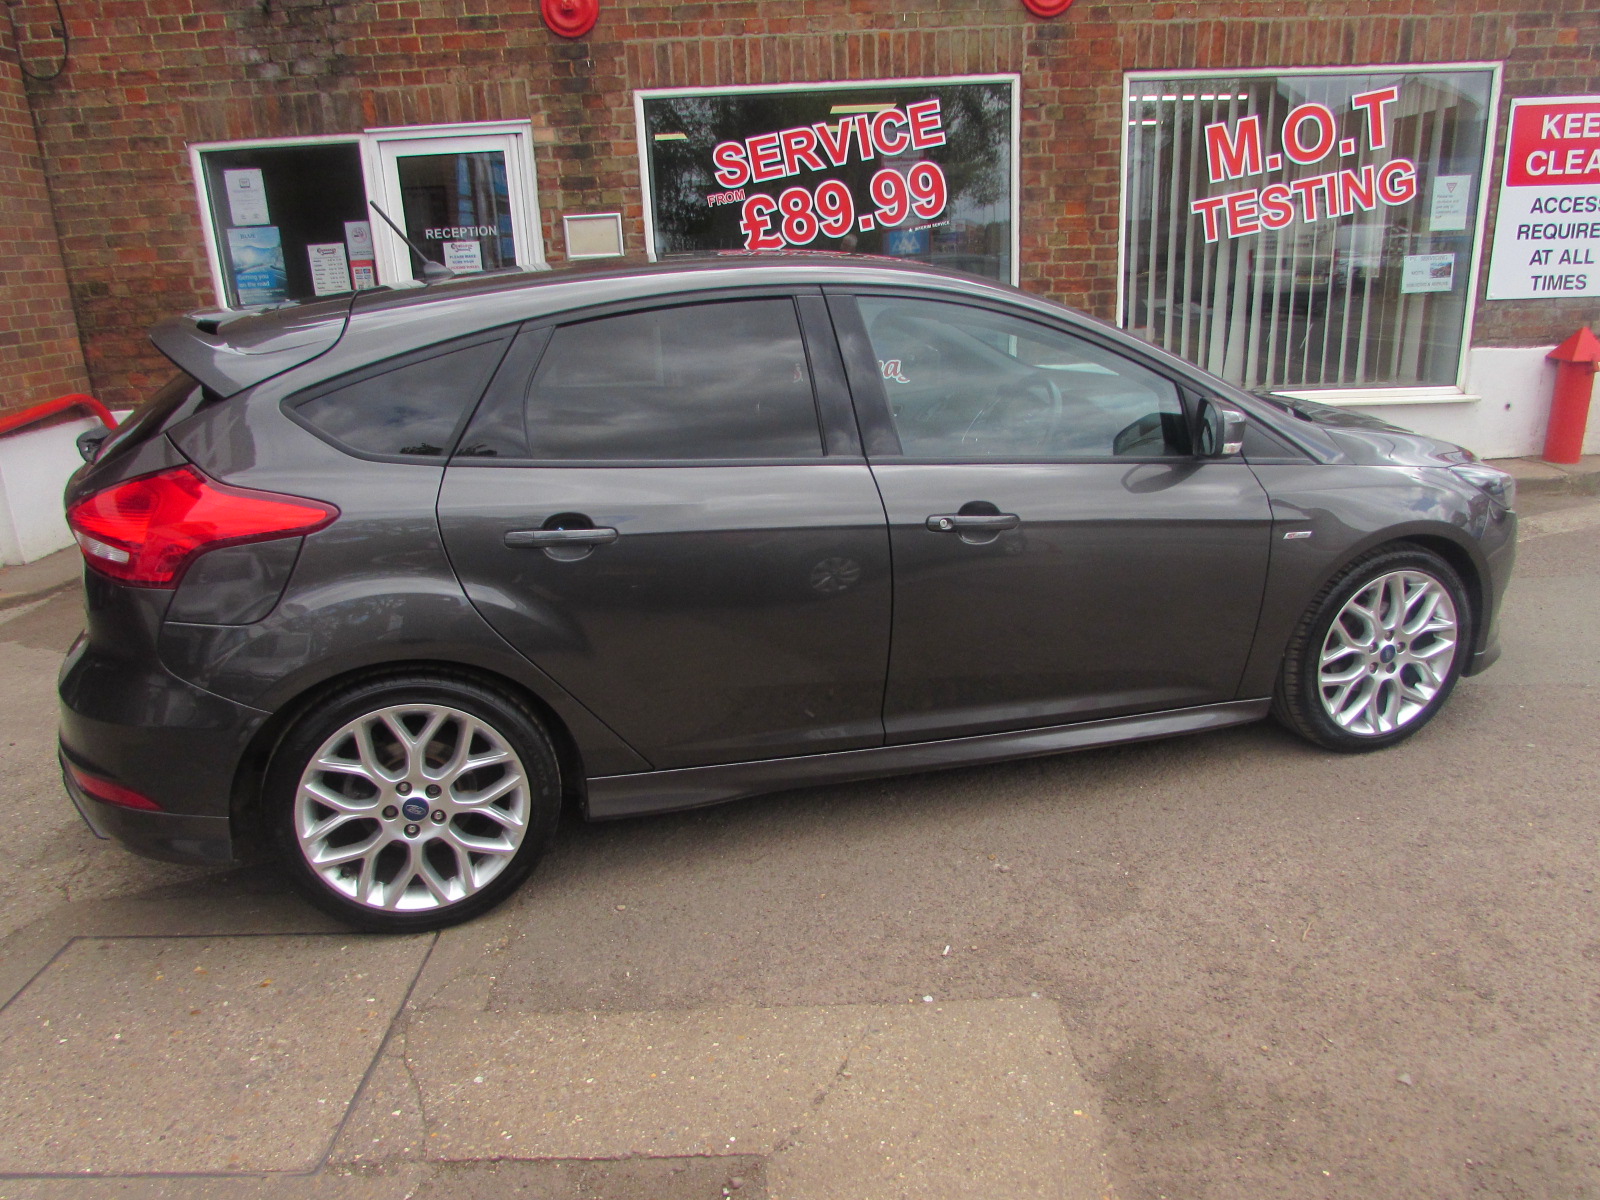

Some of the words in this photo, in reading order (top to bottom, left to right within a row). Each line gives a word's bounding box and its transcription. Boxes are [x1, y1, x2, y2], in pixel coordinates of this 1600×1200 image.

[712, 99, 946, 189] SERVICE
[1204, 86, 1398, 184] M.O.T
[707, 189, 746, 208] FROM
[739, 161, 947, 251] £89.99
[1190, 159, 1417, 244] TESTING
[1530, 196, 1600, 213] ACCES
[425, 225, 497, 240] RECEPTION
[932, 220, 950, 228] SERVICE
[1529, 249, 1553, 265] AT
[1558, 249, 1594, 265] ALL
[1531, 274, 1587, 291] TIMES
